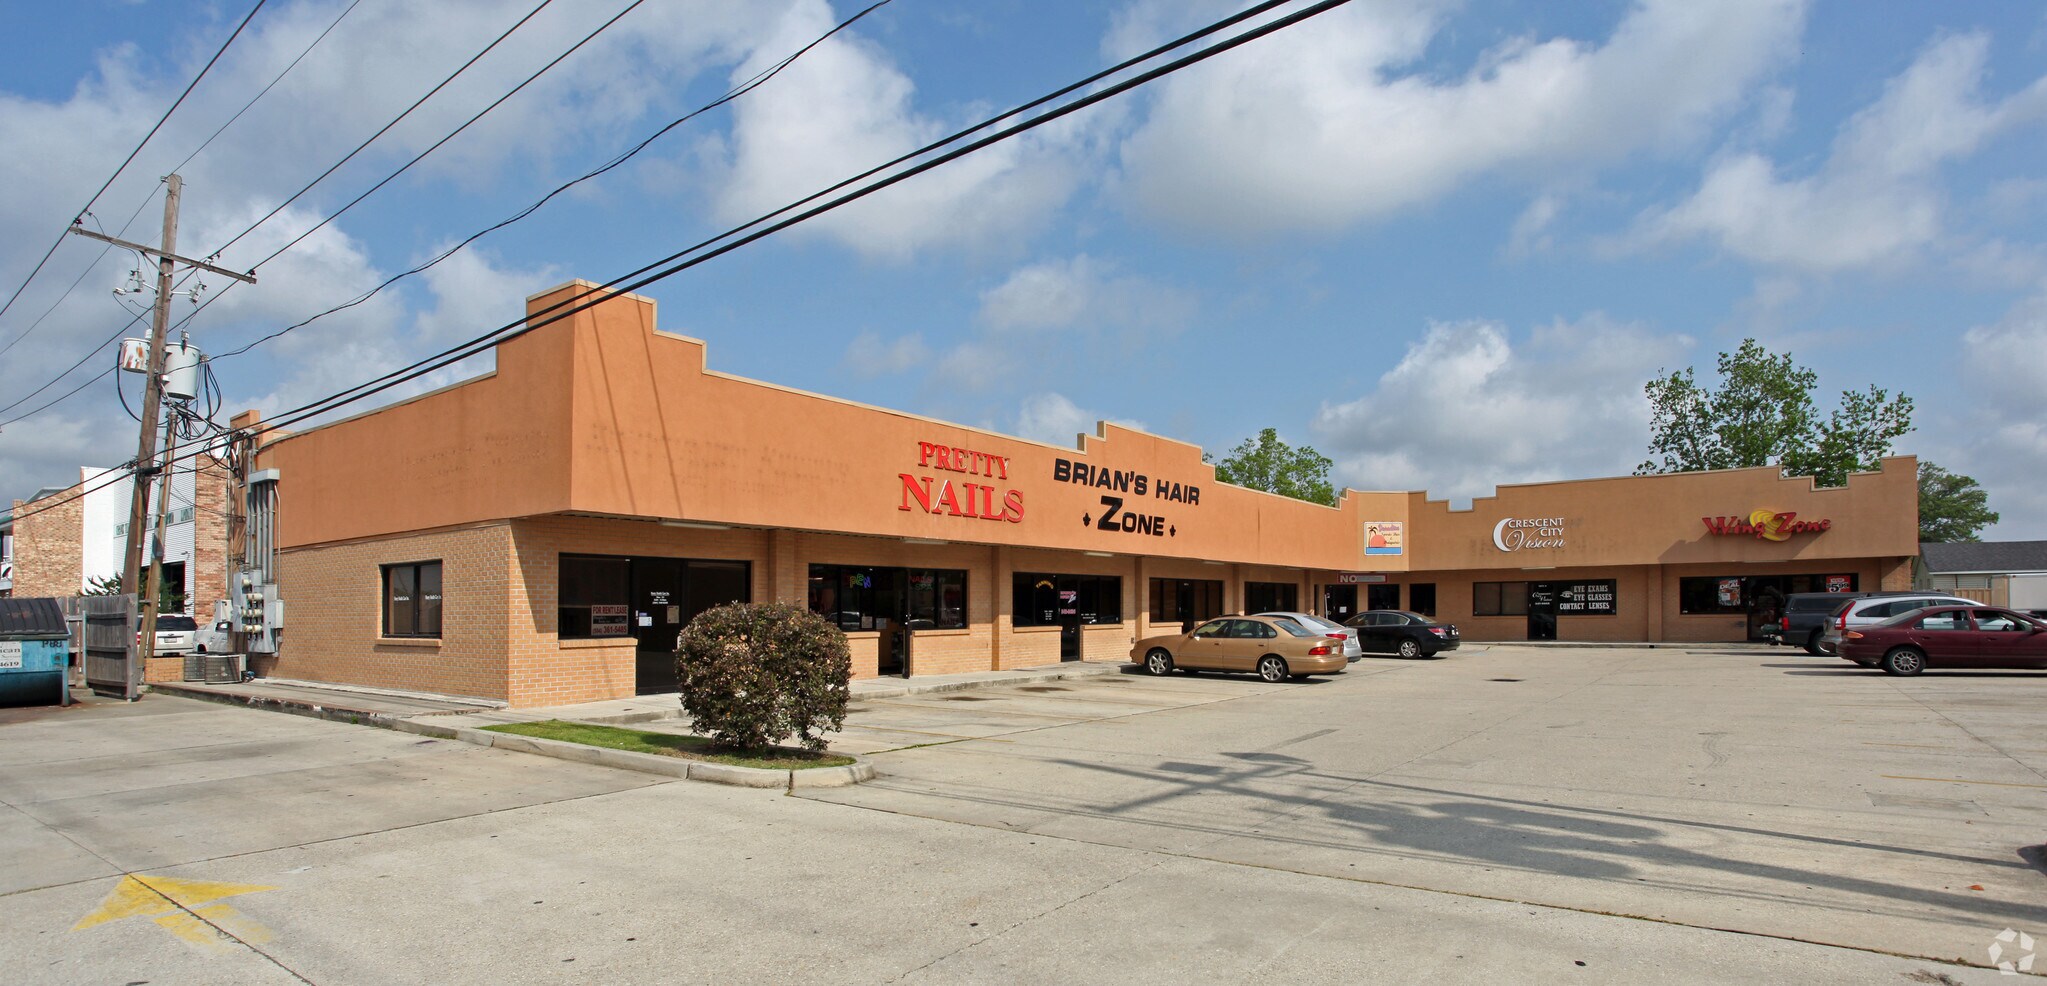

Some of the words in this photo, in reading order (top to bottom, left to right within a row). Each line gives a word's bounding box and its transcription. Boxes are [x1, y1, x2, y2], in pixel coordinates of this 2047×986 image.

[918, 441, 1010, 479] PRETTY
[1053, 458, 1148, 496] BRIAN'S
[1155, 479, 1200, 506] HAIR
[898, 473, 1025, 523] NAILS
[1097, 495, 1166, 537] ZONE
[1508, 517, 1564, 529] CRESCENT
[1701, 515, 1766, 539] Wing
[1773, 511, 1831, 534] Zone
[1505, 526, 1566, 551] Vision
[1540, 527, 1564, 537] CITY
[1340, 574, 1357, 583] NO
[592, 606, 601, 614] FOR
